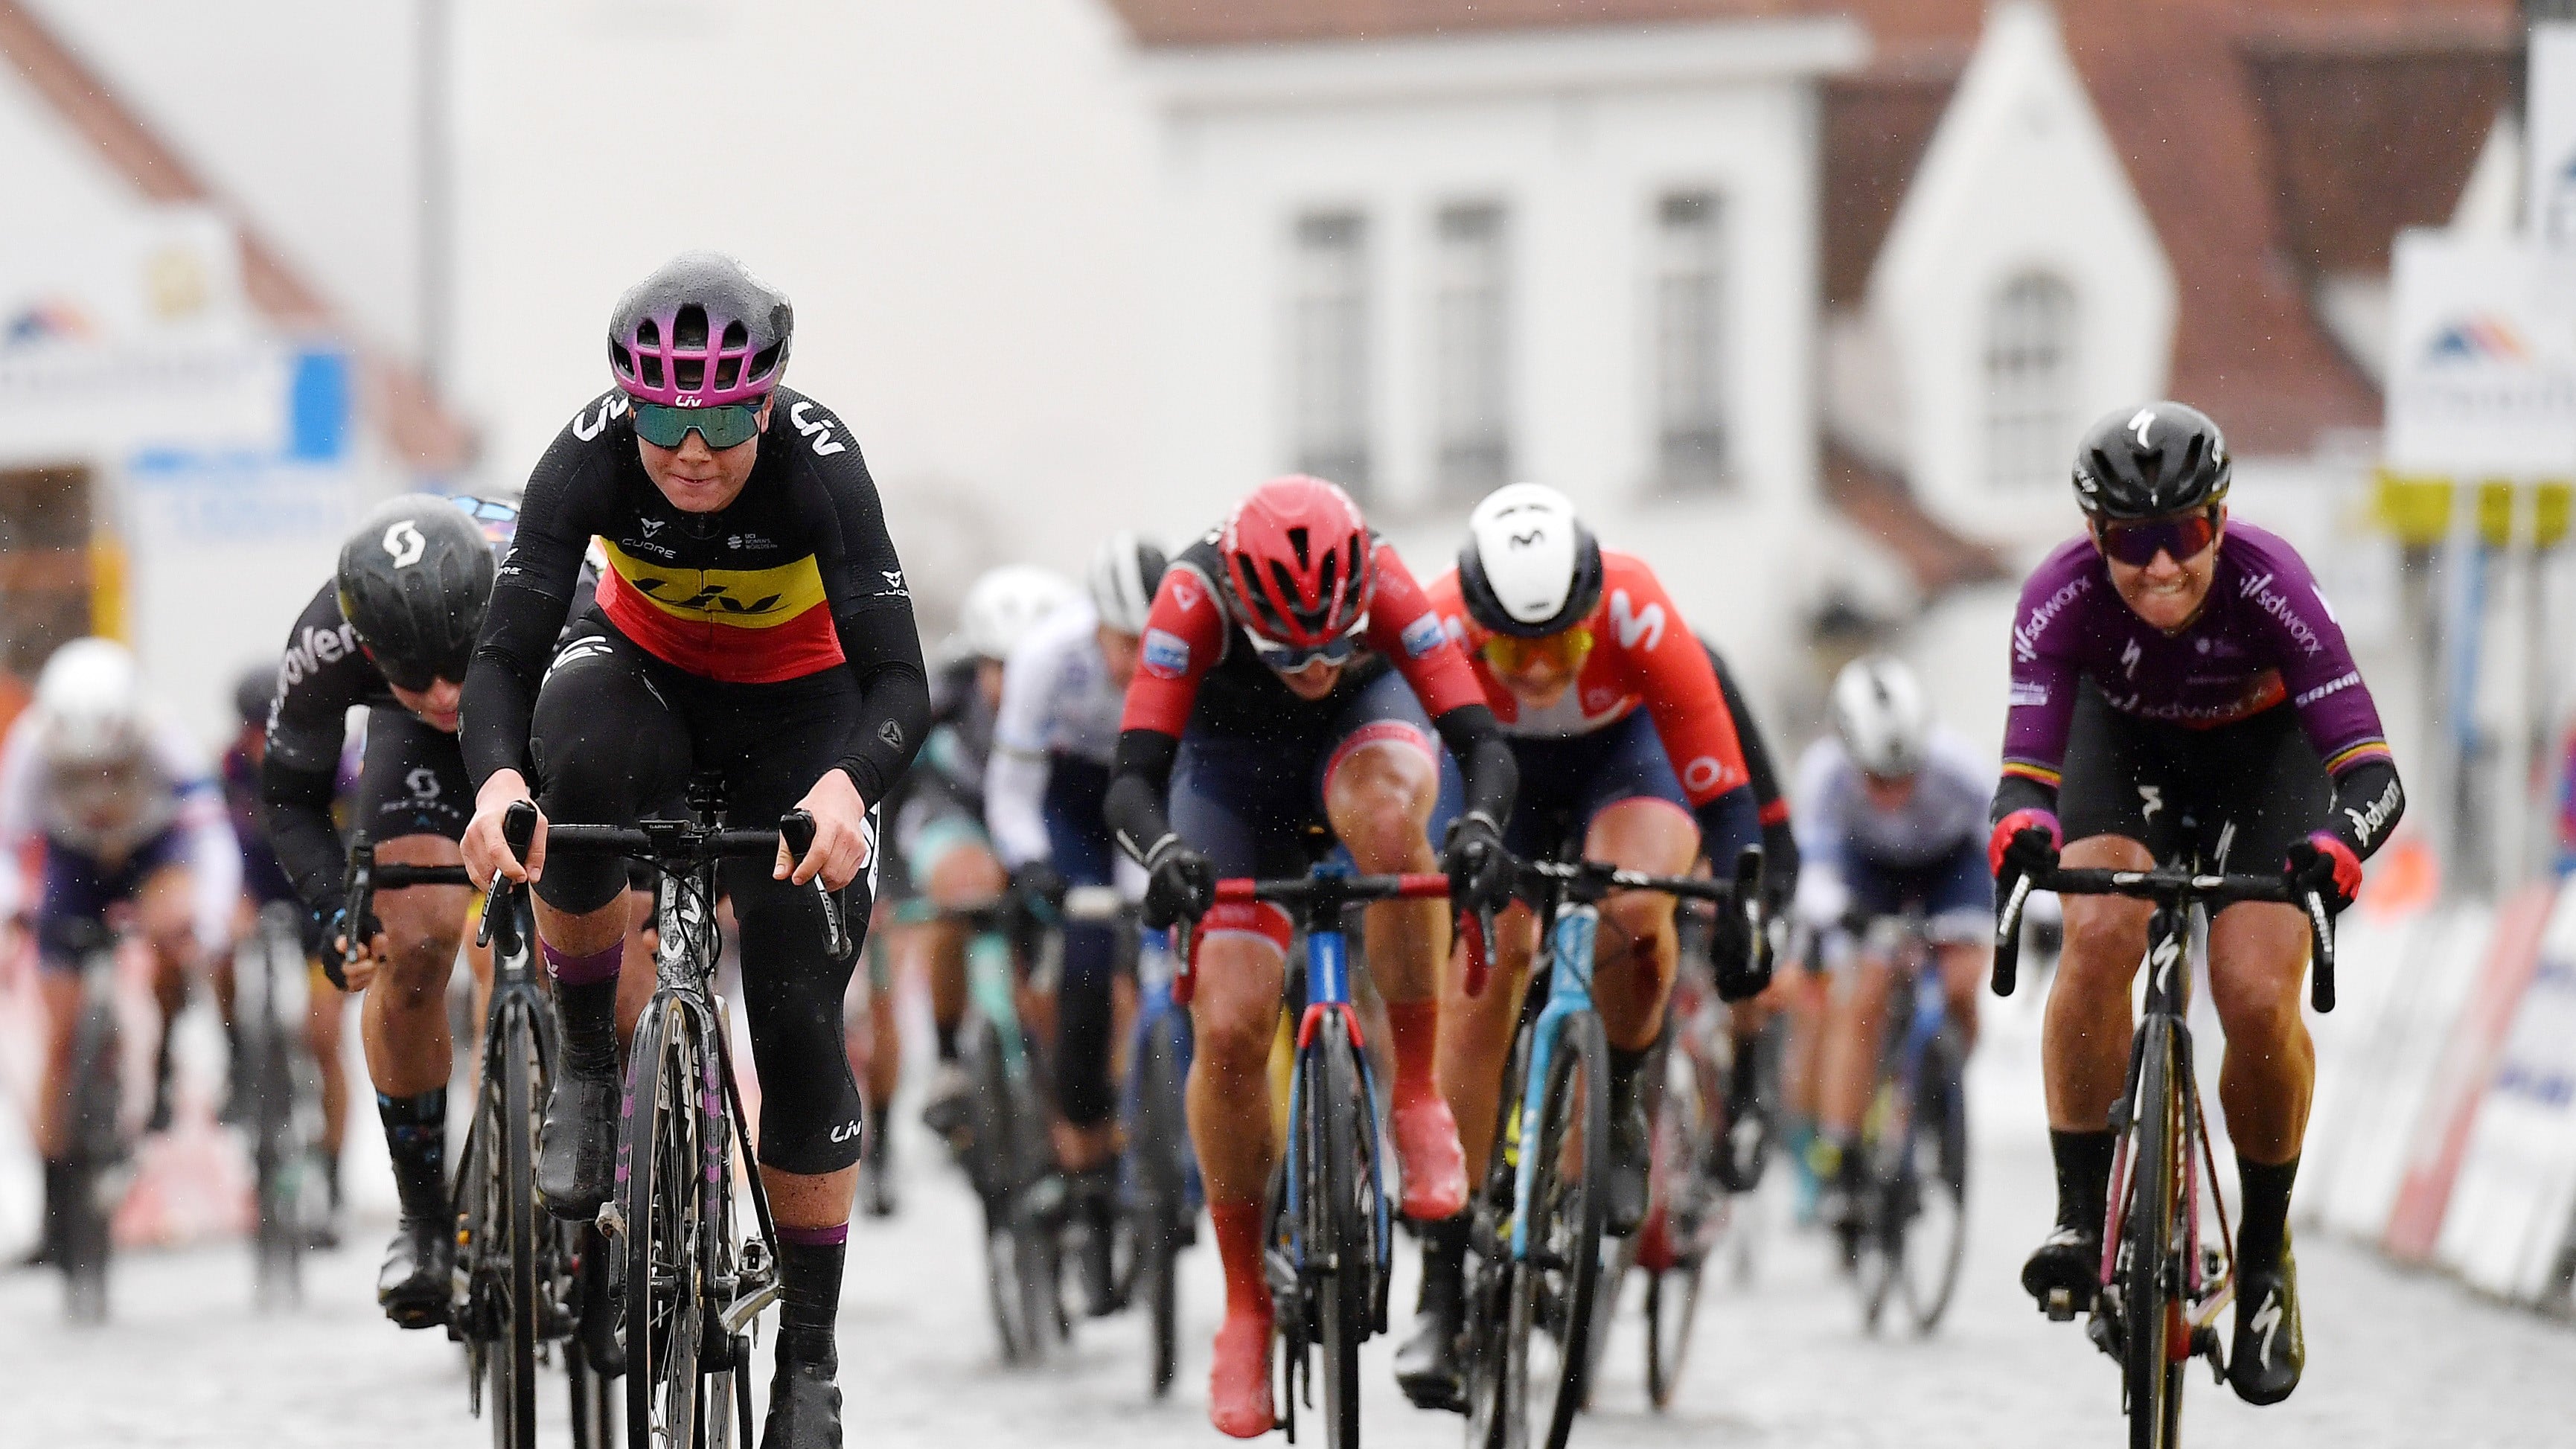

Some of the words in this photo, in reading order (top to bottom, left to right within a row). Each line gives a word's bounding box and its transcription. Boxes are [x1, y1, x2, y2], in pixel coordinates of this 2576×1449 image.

[675, 394, 702, 407] Liv
[572, 395, 629, 442] Liv
[790, 400, 846, 456] Liv
[621, 538, 677, 559] CUORE
[830, 1119, 861, 1143] Liv
